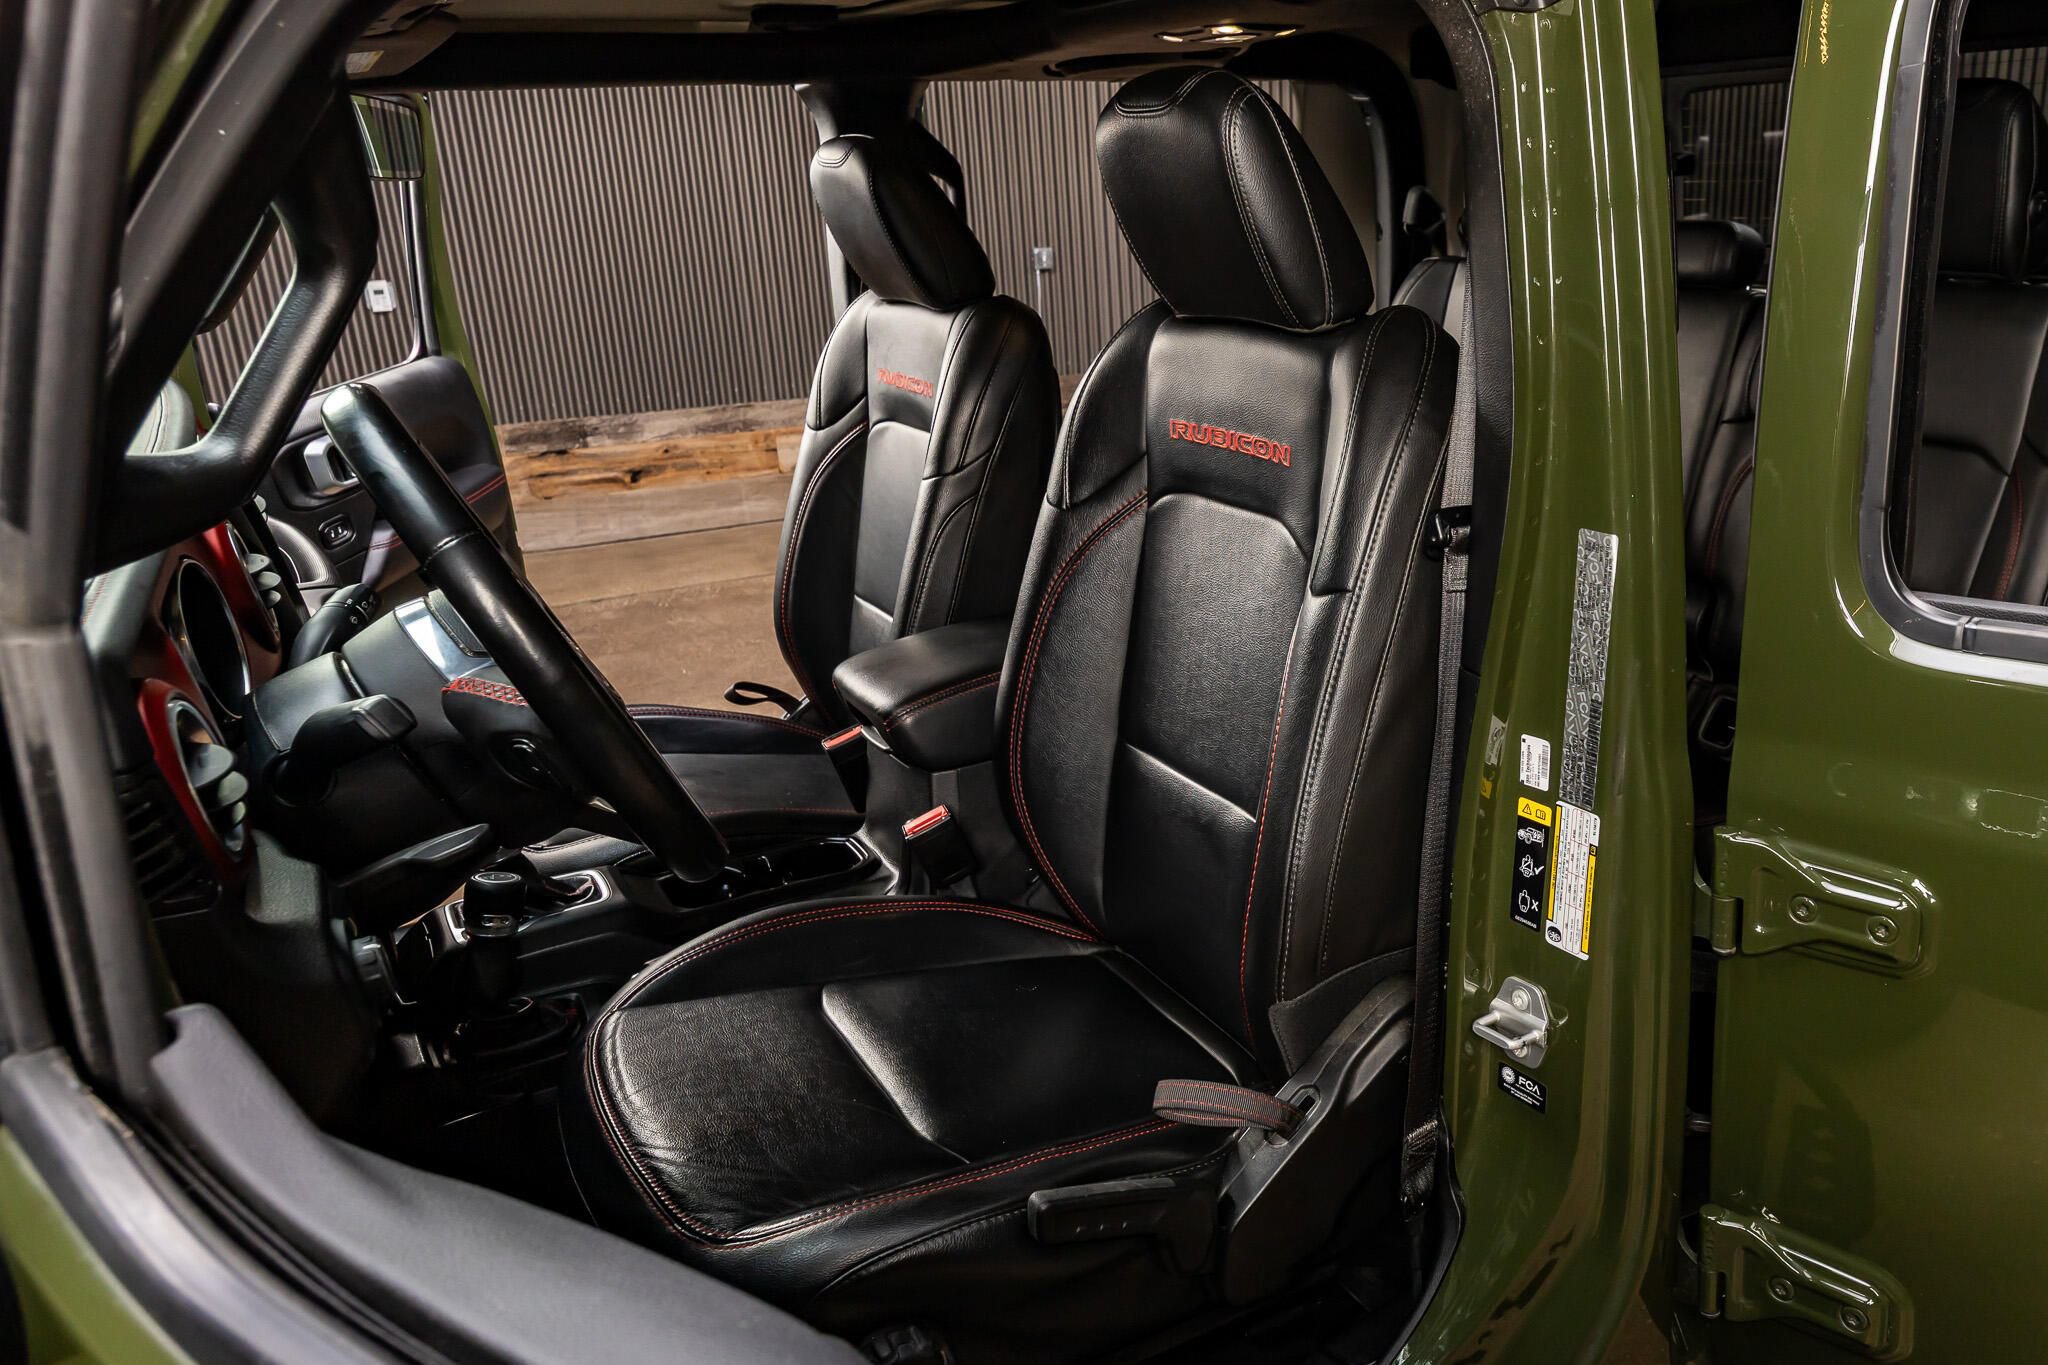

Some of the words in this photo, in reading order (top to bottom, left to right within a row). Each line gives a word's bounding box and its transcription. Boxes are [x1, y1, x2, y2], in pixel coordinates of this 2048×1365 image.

[878, 368, 934, 399] RUBICON
[1169, 419, 1291, 467] RUBICON
[1519, 1075, 1540, 1095] FCA
